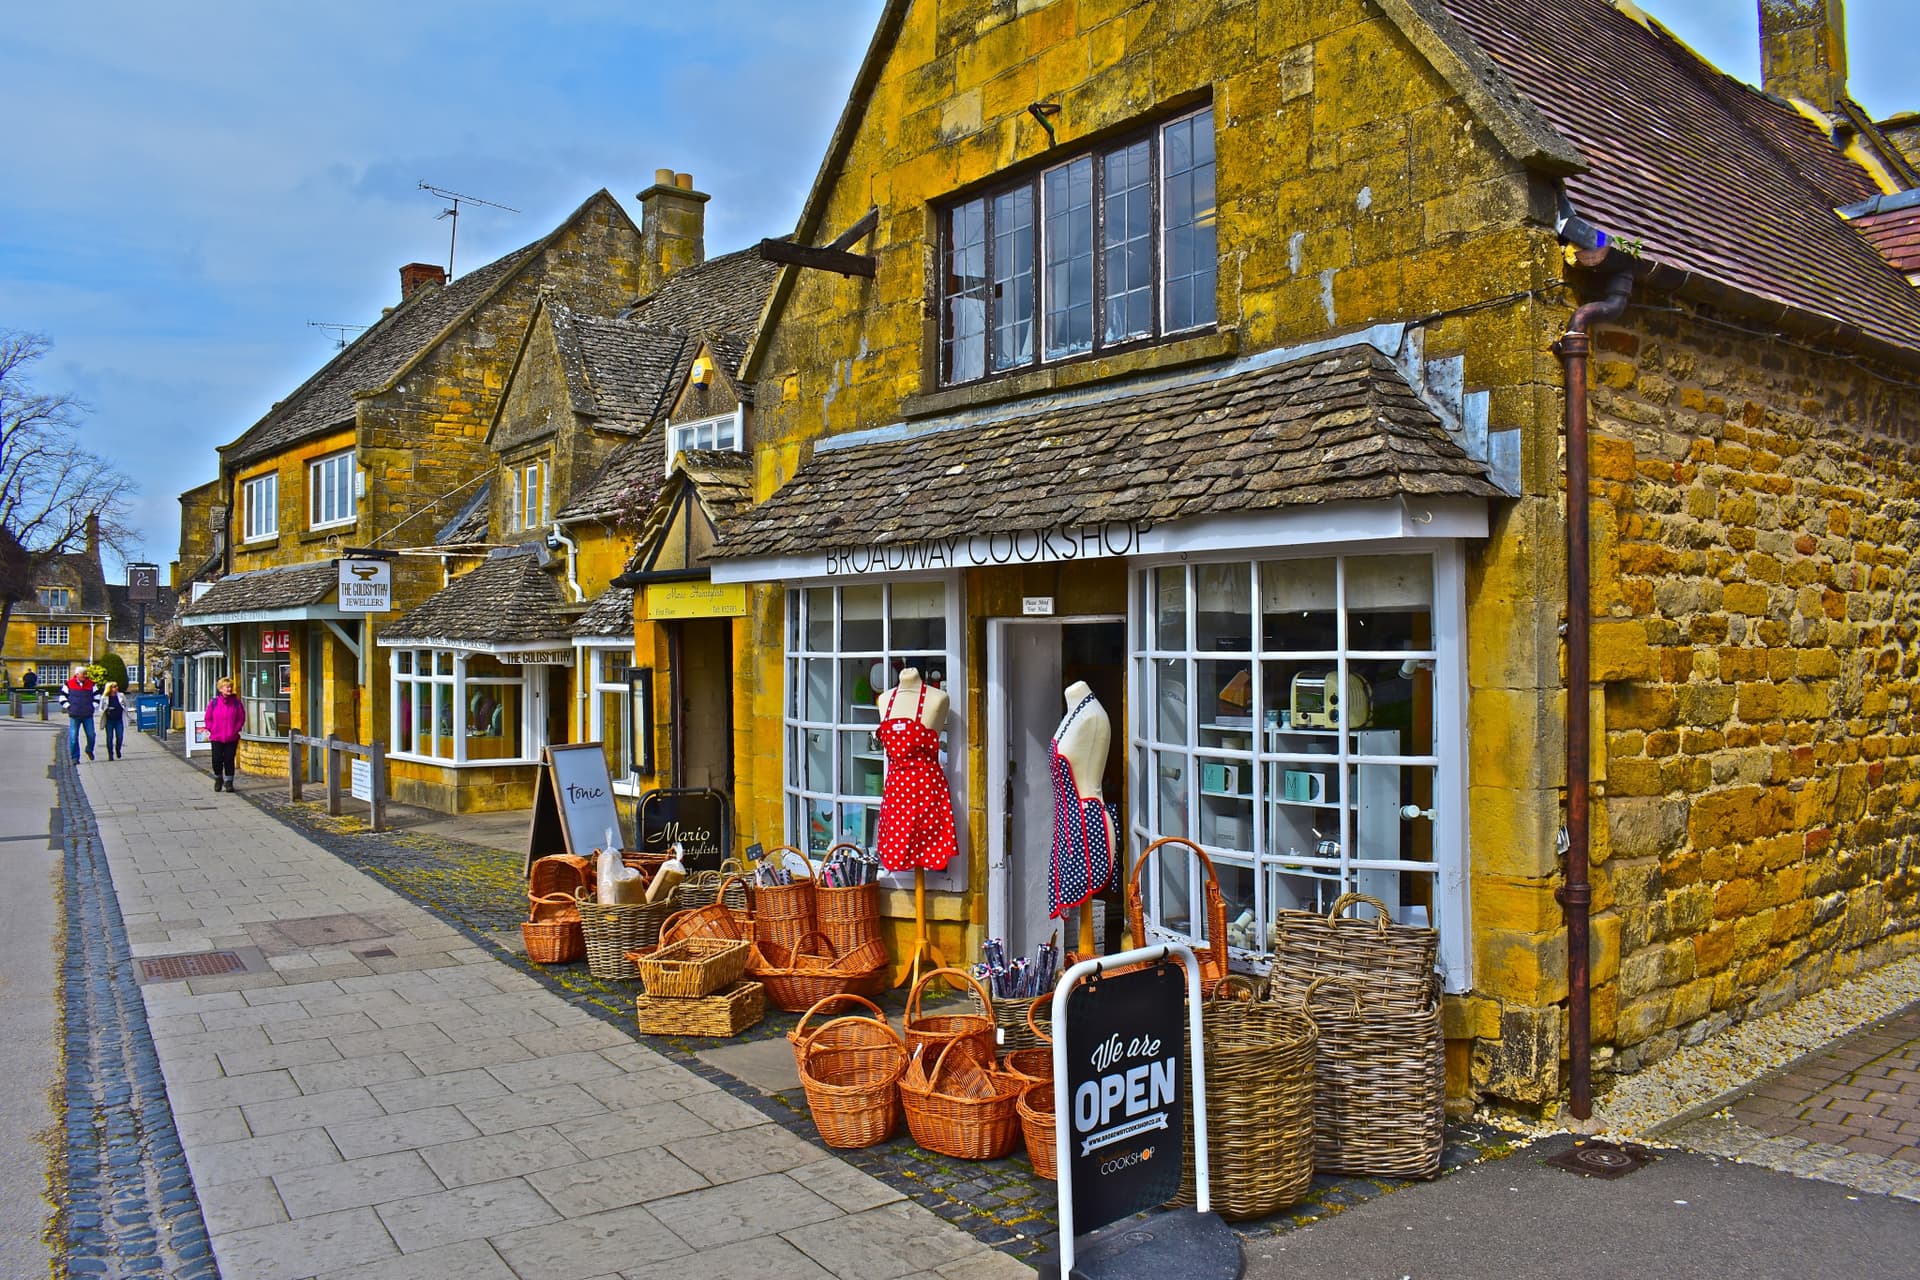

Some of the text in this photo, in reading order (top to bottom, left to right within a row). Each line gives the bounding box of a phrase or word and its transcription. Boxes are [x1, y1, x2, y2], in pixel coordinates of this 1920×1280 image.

[826, 520, 1153, 574] BROADWAY COOKSHOP
[341, 582, 388, 598] THE GOLDSMITHY
[345, 598, 384, 607] JEWELLERS
[264, 635, 290, 649] SALE
[507, 650, 570, 664] THE GOLDSMITHY
[566, 782, 605, 804] tonic
[646, 821, 711, 843] Mario
[1091, 1032, 1161, 1072] We are
[1075, 1057, 1175, 1132] OPEN
[1100, 1146, 1155, 1175] COOKSHOP
